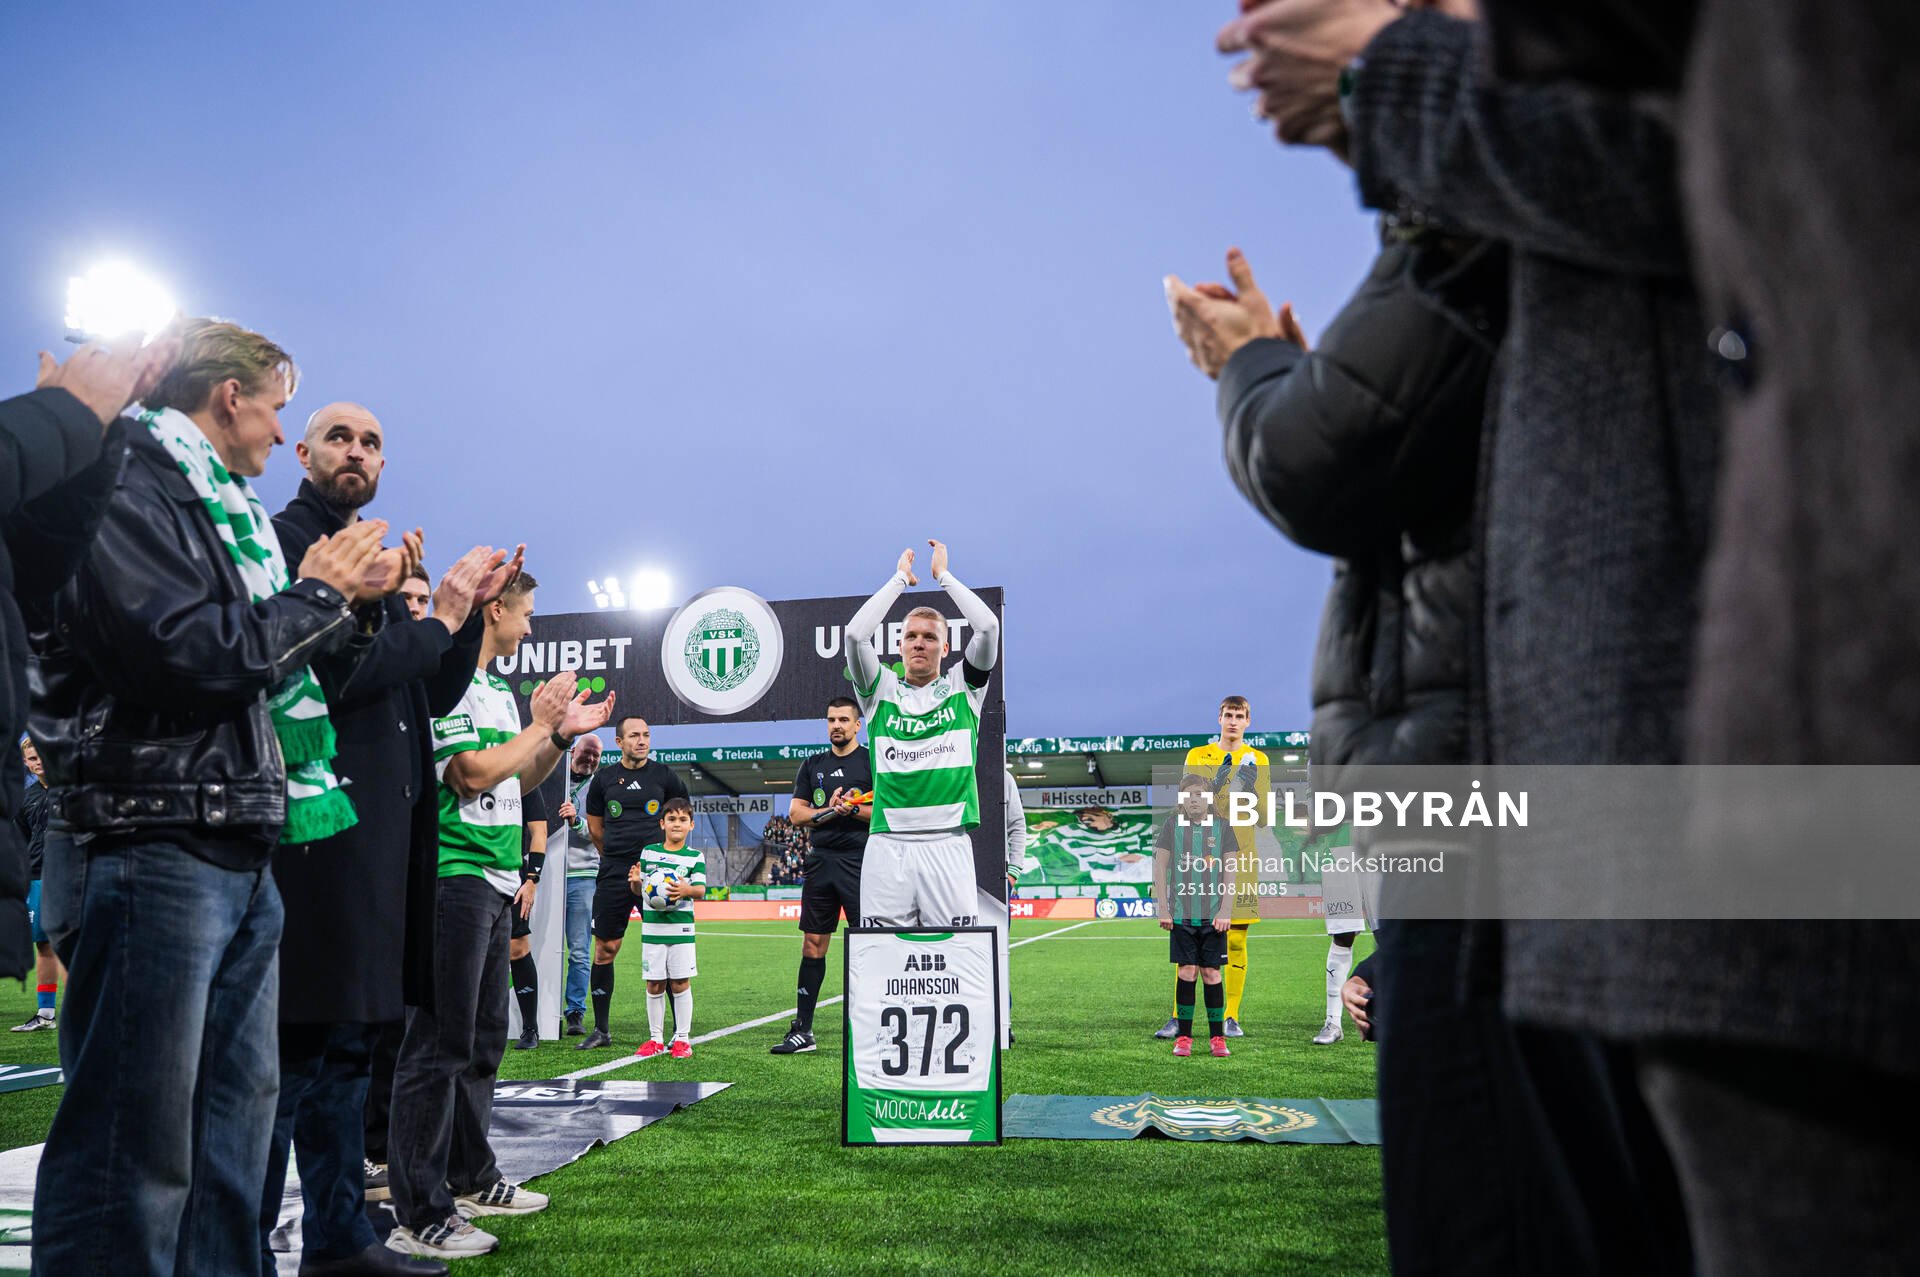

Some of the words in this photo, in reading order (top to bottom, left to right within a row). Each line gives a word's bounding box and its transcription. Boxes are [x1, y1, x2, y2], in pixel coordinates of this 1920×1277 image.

[709, 630, 736, 639] VSK
[815, 619, 969, 658] UIBT
[496, 637, 632, 675] UNIBET
[435, 717, 471, 731] UNIBET
[886, 707, 956, 733] HITACHI
[1006, 741, 1042, 753] elexia
[1147, 738, 1190, 749] Telexia
[659, 751, 697, 761] Telexia
[724, 748, 763, 759] Telexia
[1051, 791, 1114, 806] Hisstech
[1120, 790, 1142, 805] AB
[749, 799, 769, 812] AB
[1327, 901, 1354, 913] RYDS
[904, 954, 947, 972] ABB
[885, 977, 960, 996] JOHANSSON
[881, 1003, 970, 1077] 372
